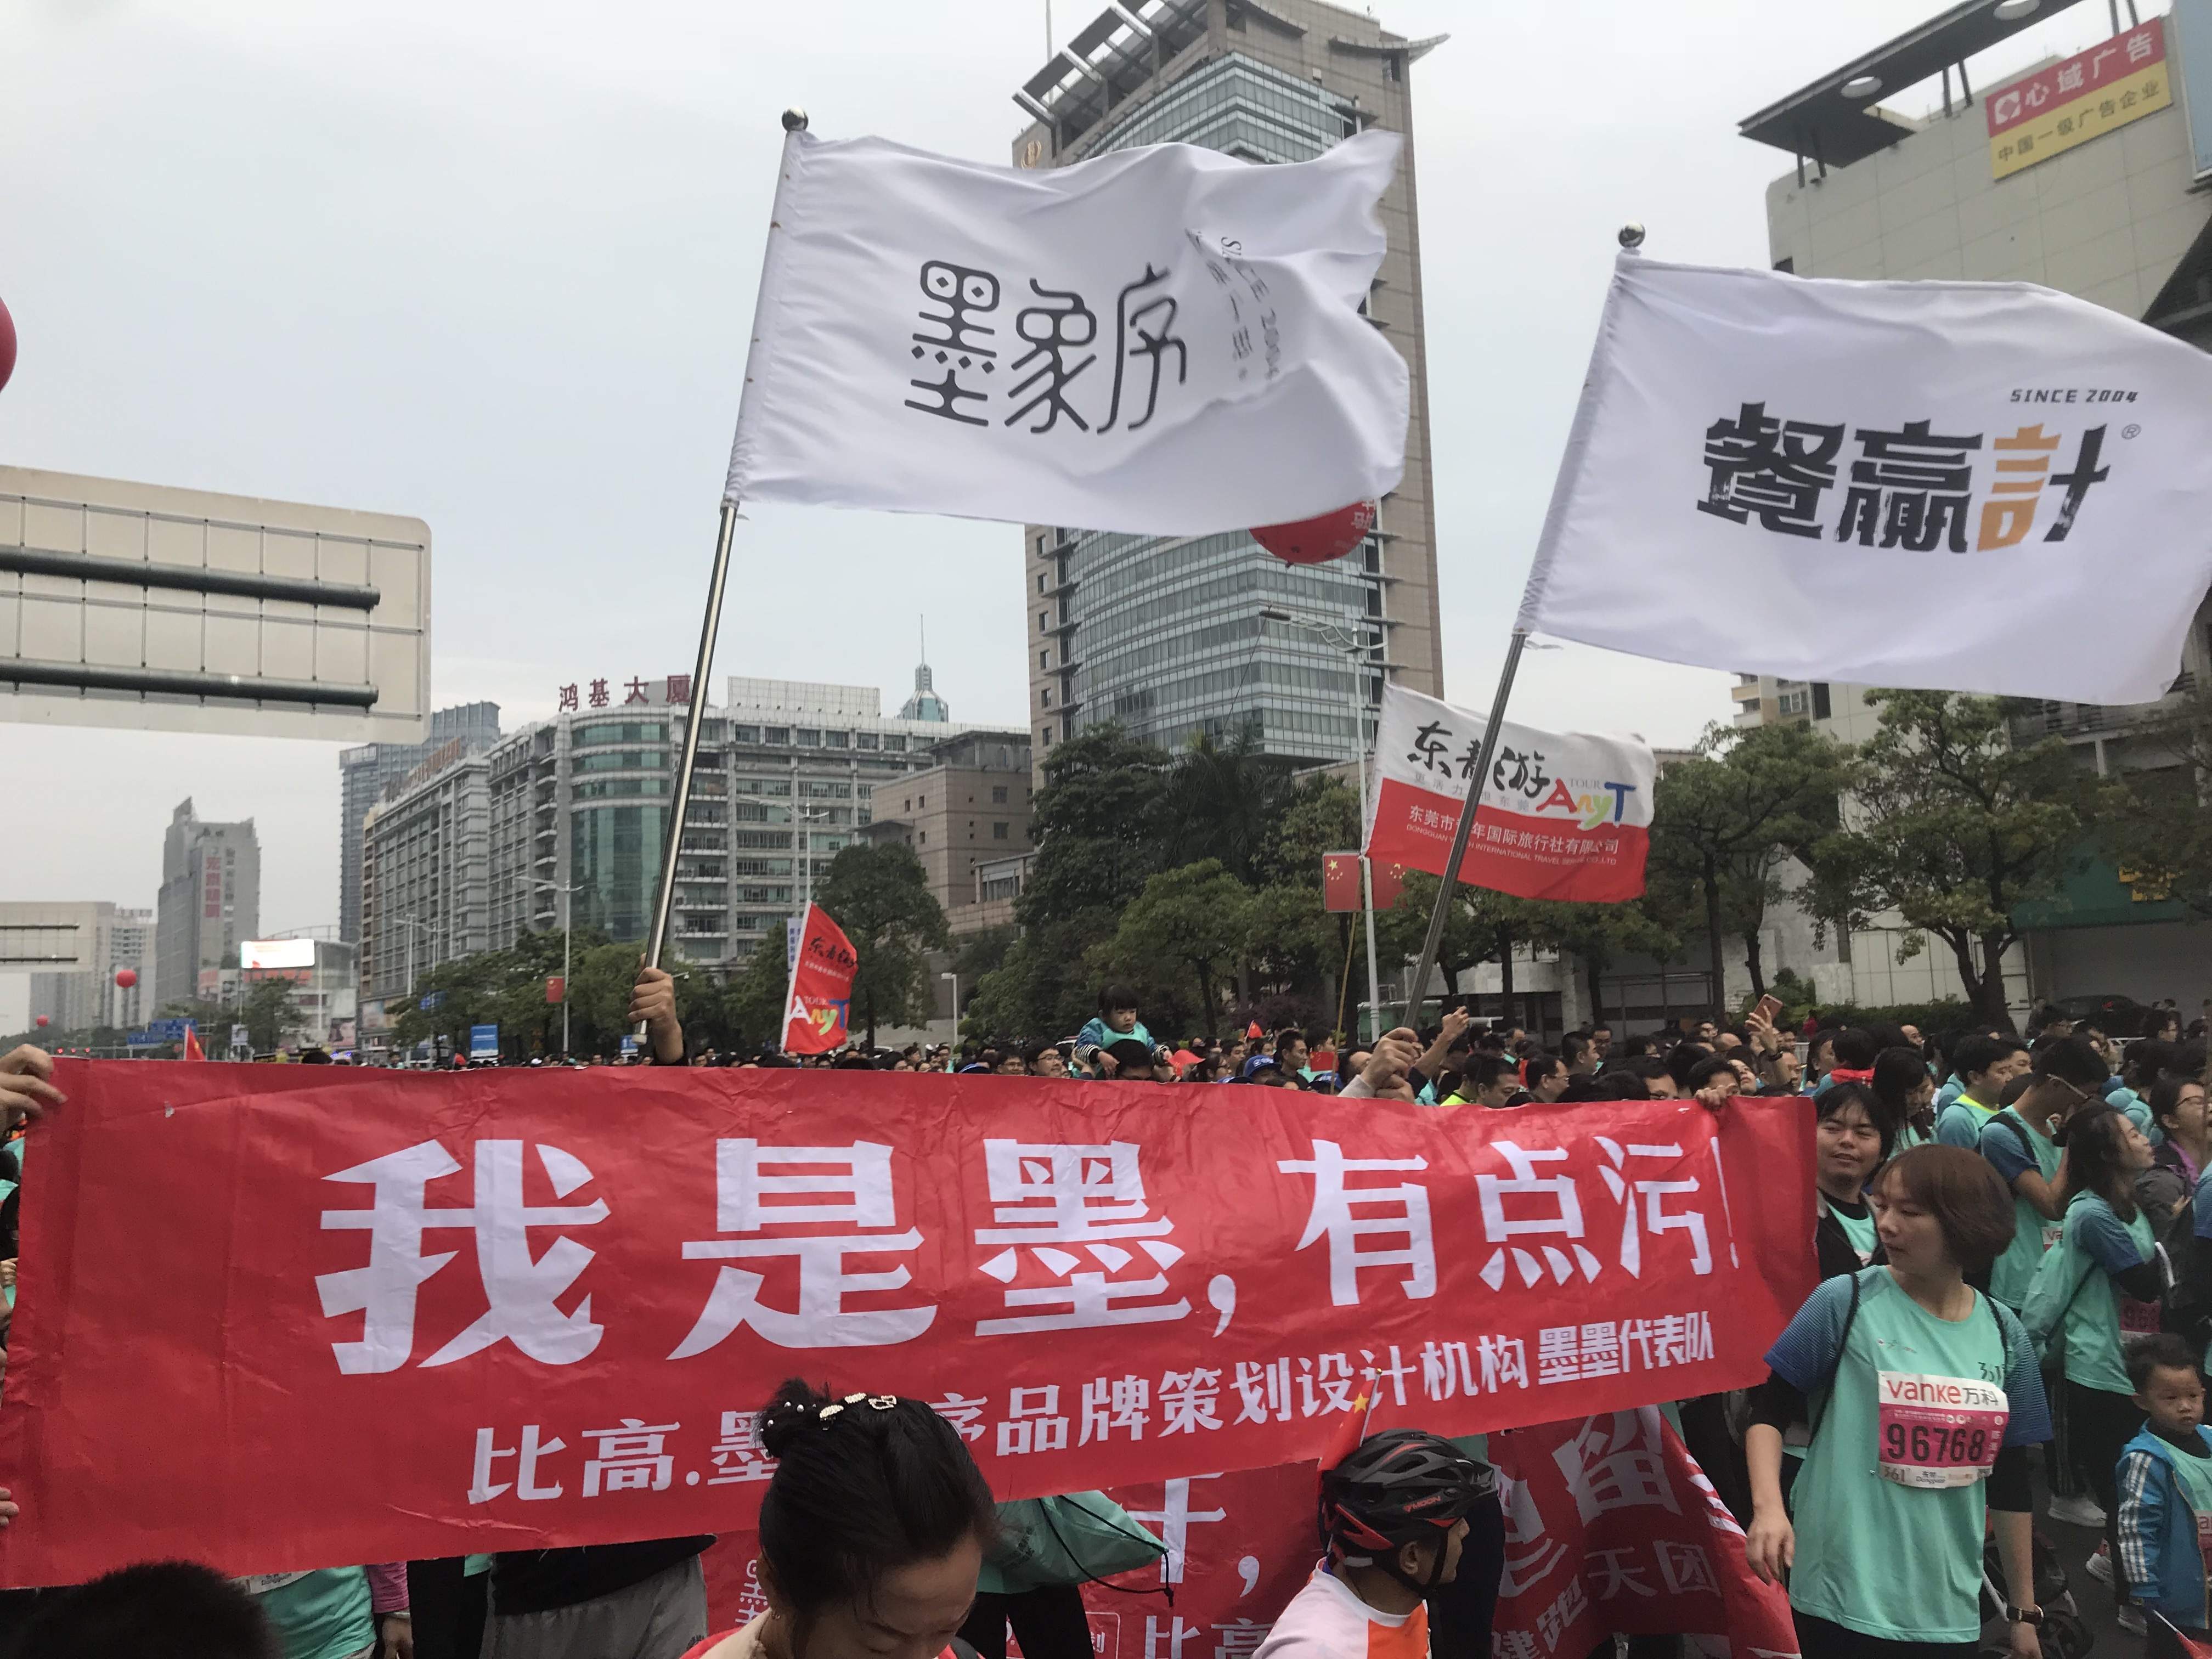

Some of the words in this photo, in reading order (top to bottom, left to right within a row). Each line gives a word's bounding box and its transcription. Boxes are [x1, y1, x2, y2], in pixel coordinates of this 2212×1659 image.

[2025, 33, 2154, 108] 心域广告
[1998, 80, 2160, 162] 中国一级广告企业
[2010, 389, 2078, 403] SINCE
[2085, 389, 2138, 403] 2004
[558, 673, 691, 712] 鸿基大厦
[1571, 778, 1601, 790] TOUR
[1409, 805, 1619, 855] 东莞市年国际旅行社有限公司
[1963, 1387, 1999, 1406] 万科
[1887, 1424, 1986, 1462] 96768
